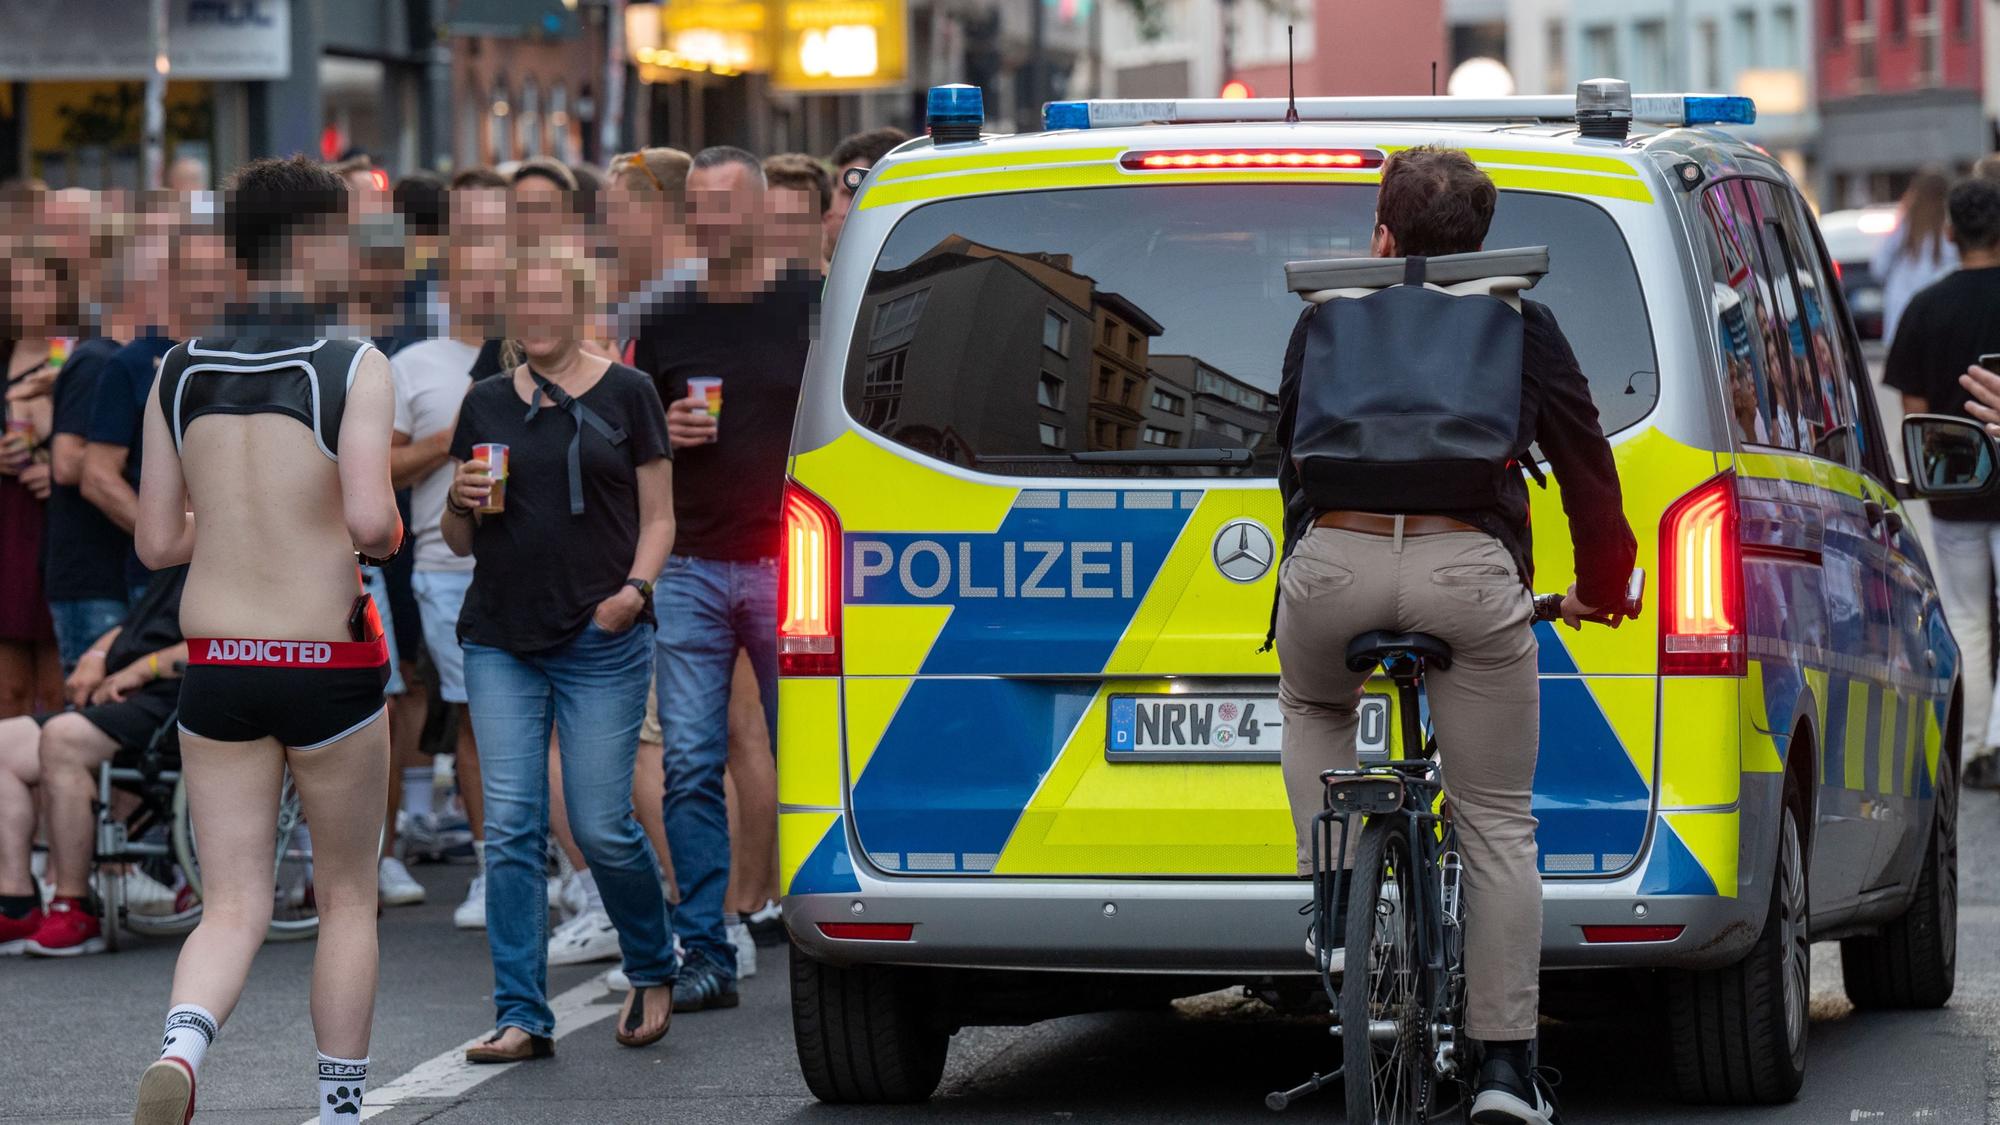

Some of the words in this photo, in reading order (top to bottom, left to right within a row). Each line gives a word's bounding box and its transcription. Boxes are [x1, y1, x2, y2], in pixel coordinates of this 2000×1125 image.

[853, 540, 1134, 598] POLIZEI
[207, 639, 332, 663] ADDICTED
[1136, 703, 1214, 745] NRW
[1116, 730, 1127, 743] D
[320, 1064, 366, 1075] GEAR
